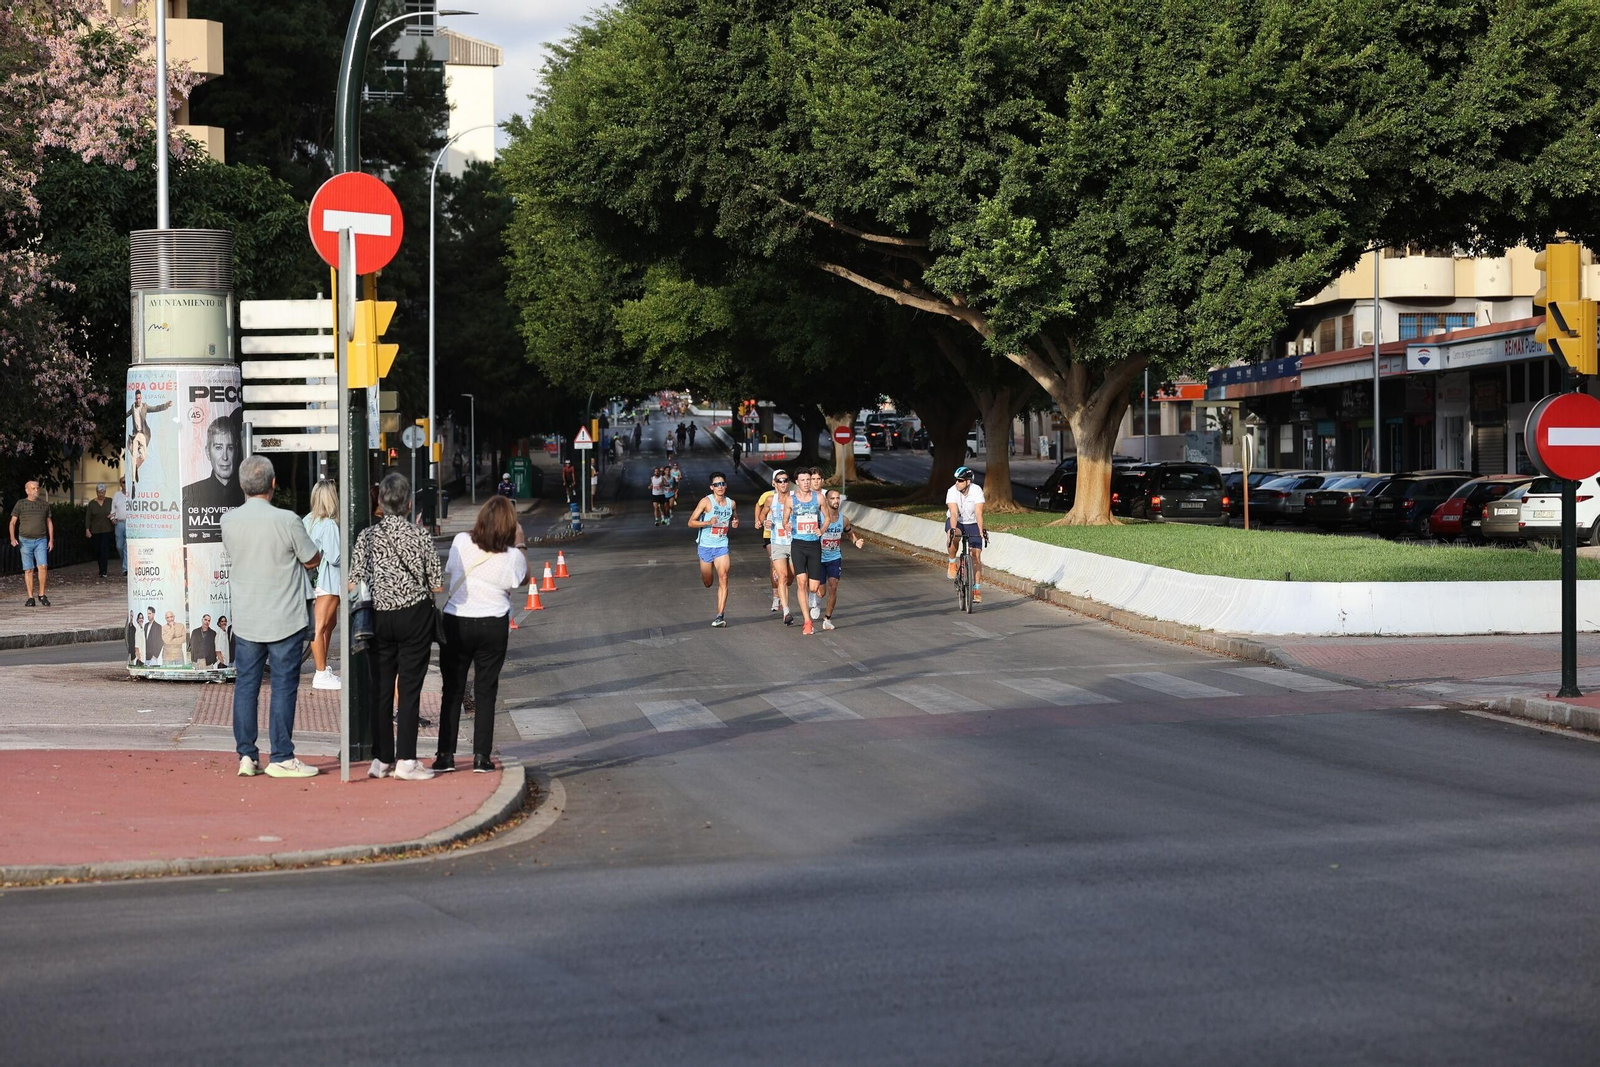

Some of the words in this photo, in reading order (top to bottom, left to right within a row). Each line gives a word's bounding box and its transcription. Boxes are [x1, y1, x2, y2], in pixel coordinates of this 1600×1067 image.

[149, 299, 215, 307] AYUNTAMIENTO
[1504, 338, 1524, 357] RE/MAX
[190, 410, 201, 419] 45
[801, 523, 814, 531] 107
[138, 566, 160, 576] GUACO
[132, 587, 164, 597] MÁLAGA
